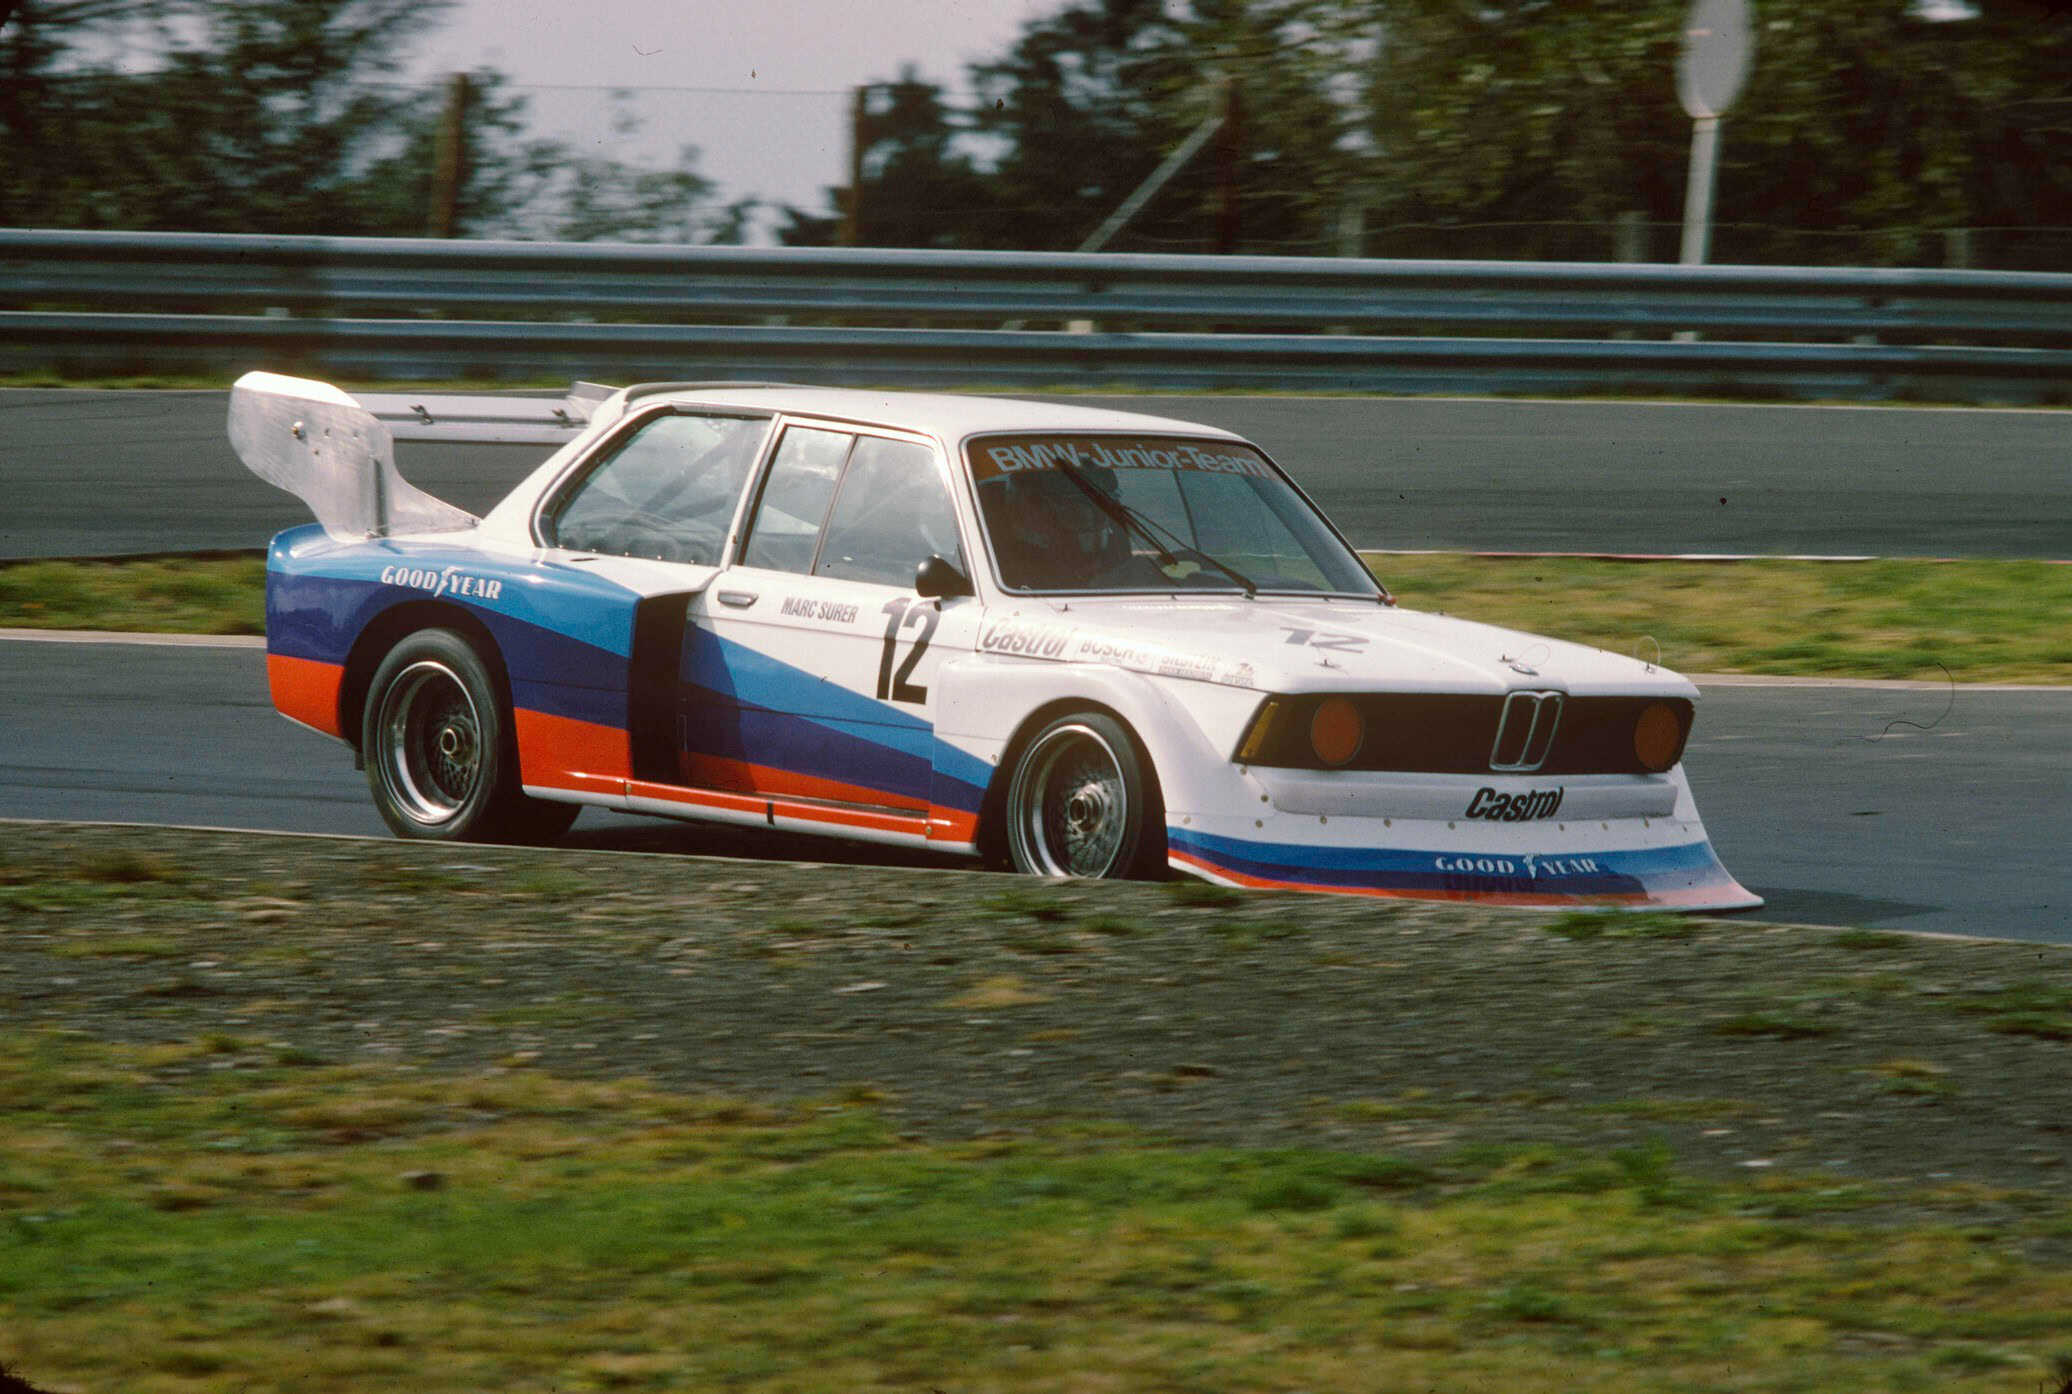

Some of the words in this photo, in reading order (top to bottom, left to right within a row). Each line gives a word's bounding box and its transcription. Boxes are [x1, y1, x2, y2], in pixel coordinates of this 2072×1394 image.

[380, 565, 502, 599] GOODYEAR
[781, 597, 816, 618] MARC
[817, 602, 859, 624] SURER
[877, 597, 941, 705] 12
[1465, 786, 1564, 822] Castrol
